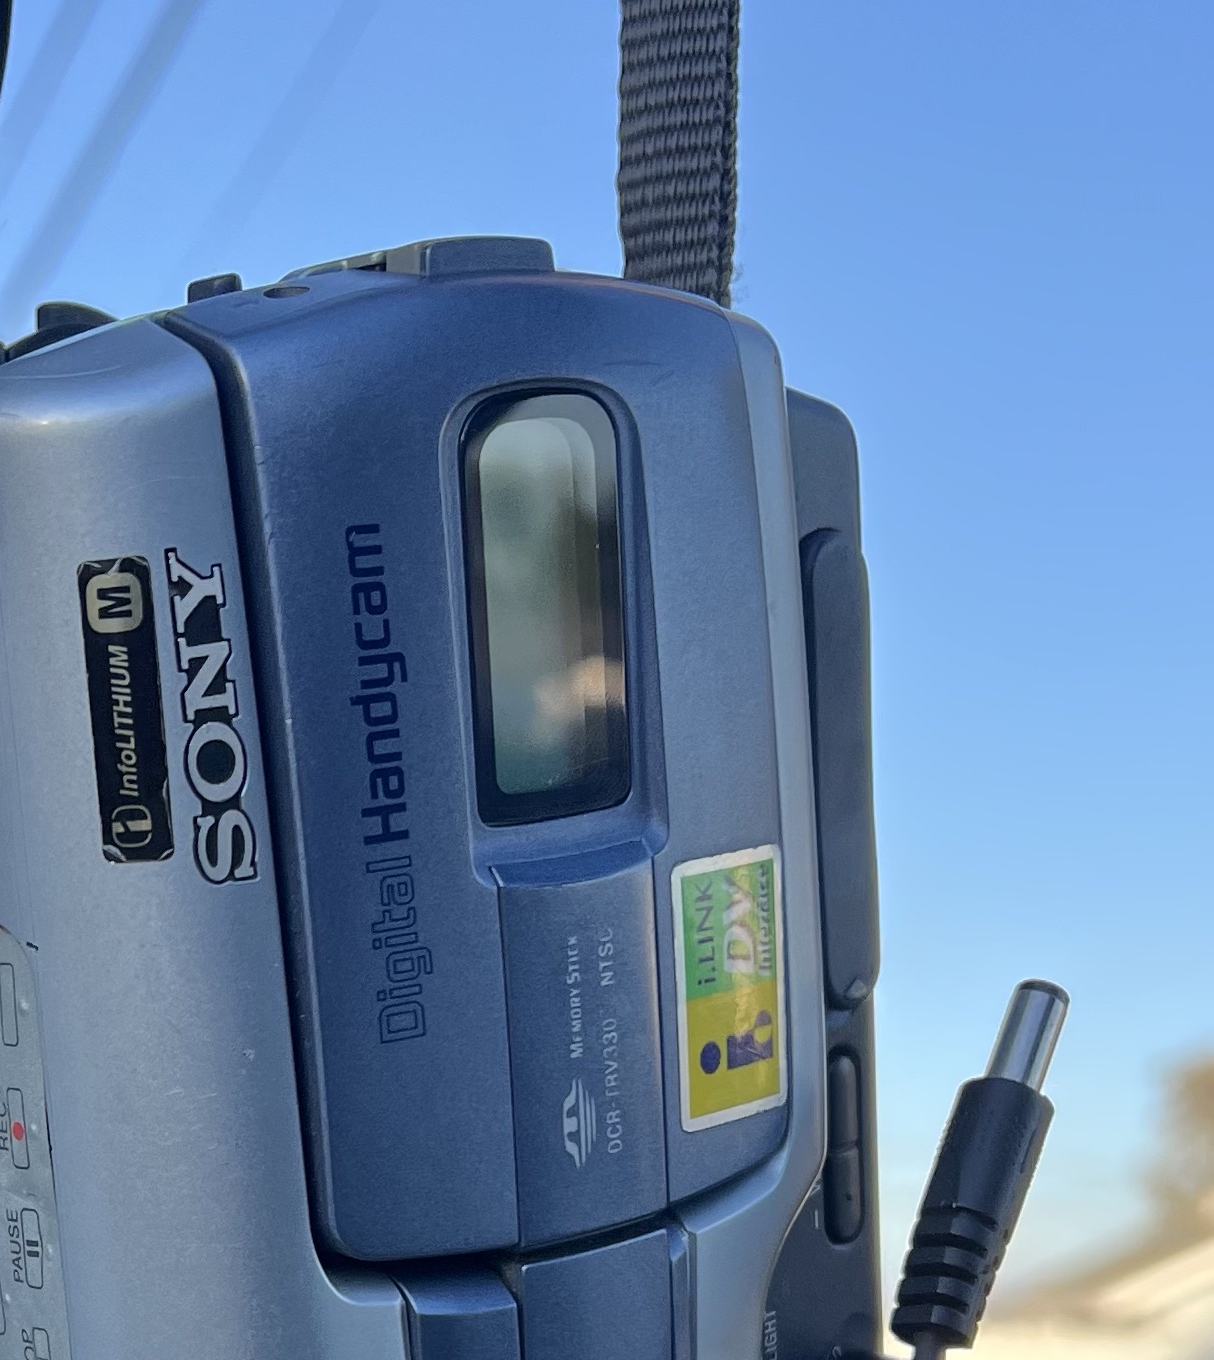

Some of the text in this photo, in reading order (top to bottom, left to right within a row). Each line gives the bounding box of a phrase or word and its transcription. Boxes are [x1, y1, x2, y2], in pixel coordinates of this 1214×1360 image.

[97, 586, 132, 621] M
[108, 645, 140, 797] InfoLITHIUM
[164, 548, 258, 885] SONY
[344, 522, 434, 1044] Digital Handycam
[693, 878, 716, 985] i.LINK
[721, 876, 755, 973] DV
[597, 928, 624, 1154] DCR-TRV330 NTSC
[7, 1208, 23, 1283] PAUSE
